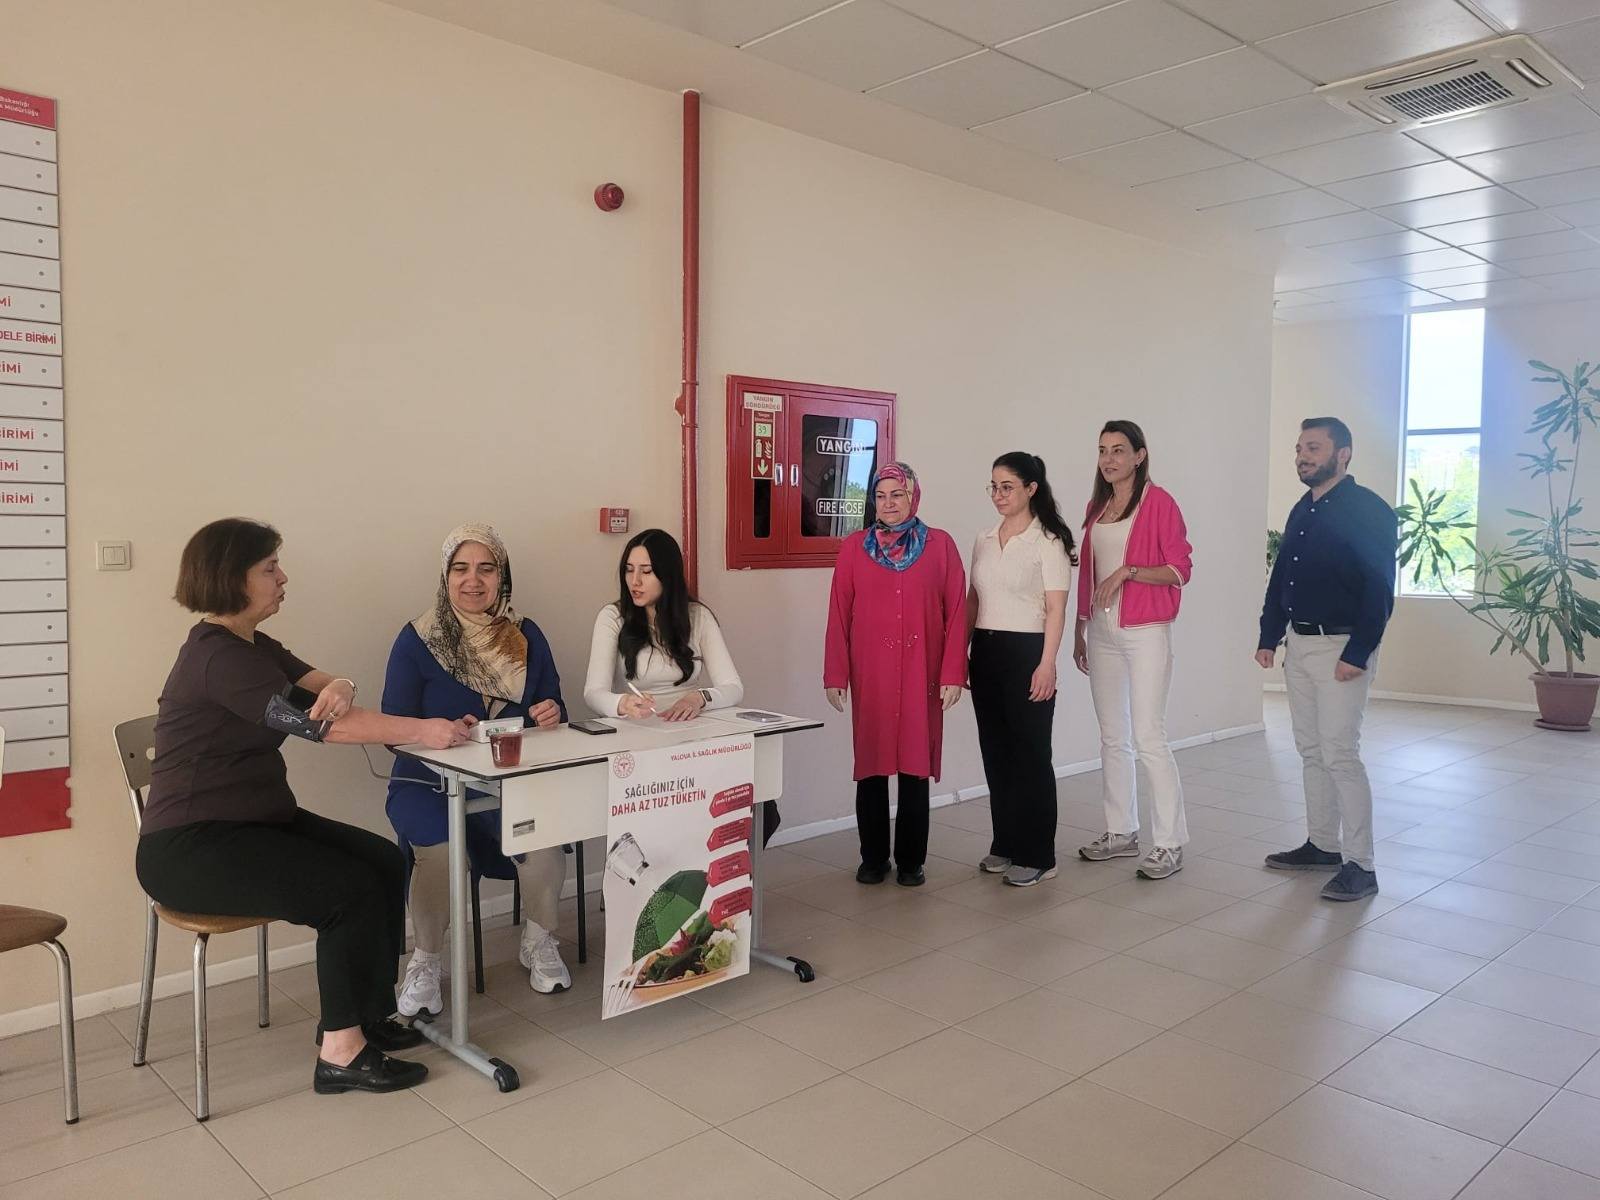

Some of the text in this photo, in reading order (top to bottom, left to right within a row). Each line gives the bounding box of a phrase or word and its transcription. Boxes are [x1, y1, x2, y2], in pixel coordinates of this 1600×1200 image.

[25, 332, 57, 345] BİRİMİ
[0, 427, 34, 440] İRİMİ
[0, 491, 34, 504] İRİMİ
[818, 501, 863, 514] FIRE HOSE
[671, 753, 691, 761] YALOVA
[698, 748, 718, 757] SAĞLIK
[624, 776, 695, 799] SAĞLIĞINIZ İÇİN
[611, 803, 636, 817] DAHA
[638, 799, 650, 812] AZ
[652, 796, 669, 809] TUZ
[671, 789, 706, 806] TÜKETİN
